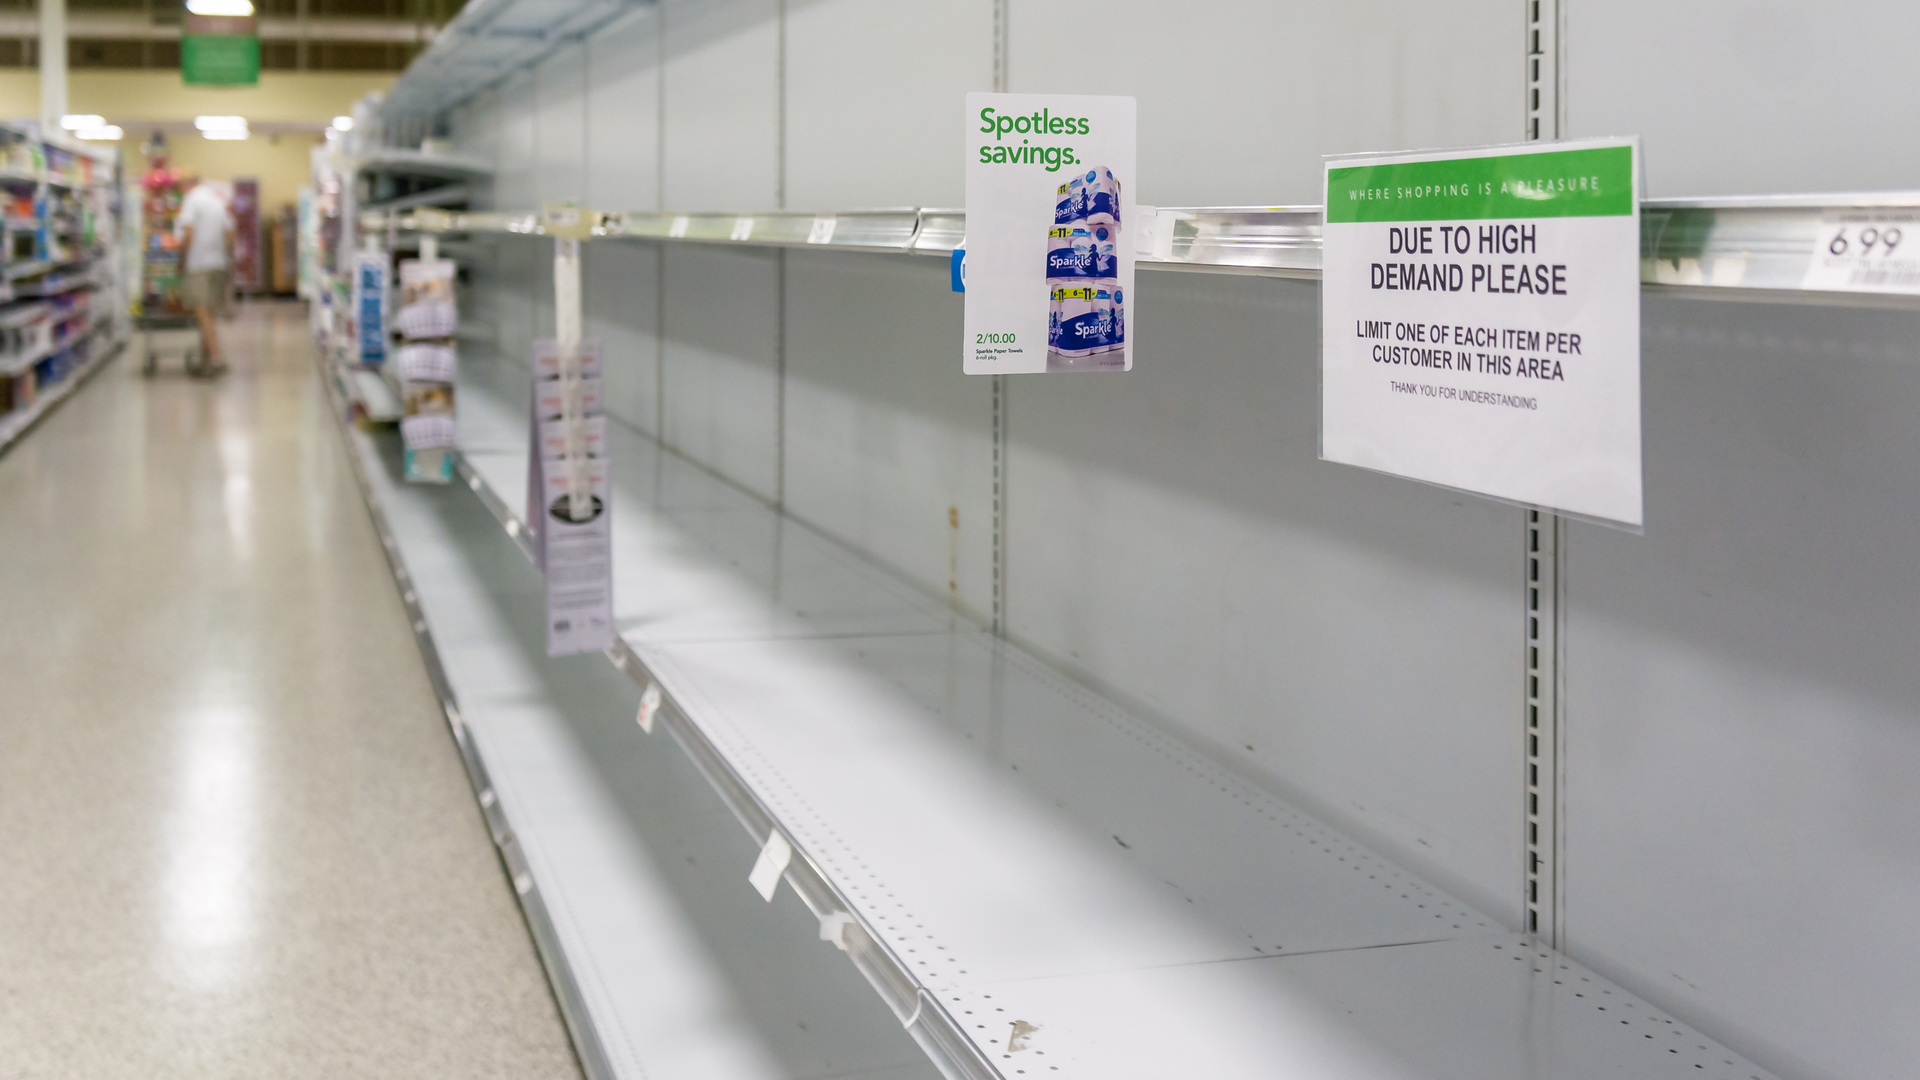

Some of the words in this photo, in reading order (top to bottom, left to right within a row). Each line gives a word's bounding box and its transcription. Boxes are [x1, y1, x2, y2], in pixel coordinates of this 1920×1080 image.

[979, 107, 1090, 141] Spotless
[979, 139, 1081, 173] savings.
[1349, 187, 1390, 201] WHERE
[1397, 183, 1469, 199] SHOPPING
[1478, 181, 1492, 196] IS
[1500, 181, 1509, 195] A
[1517, 175, 1599, 195] PLEASURE
[1389, 226, 1433, 255] DUE
[1440, 225, 1471, 255] TO
[1478, 224, 1537, 254] HIGH
[1049, 253, 1091, 269] Sparkle
[1370, 262, 1464, 292] DEMAND
[1471, 264, 1568, 296] PLEASE
[976, 332, 1016, 344] 2/10.00
[1075, 320, 1112, 339] Sparkle
[1356, 319, 1392, 340] LIMIT
[1395, 322, 1426, 343] ONE
[1429, 324, 1450, 344] OF
[1454, 326, 1498, 348] EACH
[1502, 329, 1541, 352] ITEM
[1545, 332, 1583, 355] PER
[1372, 344, 1452, 370] CUSTOMER
[1457, 352, 1472, 372] IN
[1476, 353, 1512, 376] THIS
[1516, 357, 1565, 382] AREA
[1390, 380, 1418, 395] THANK
[1419, 384, 1437, 398] YOU
[1438, 386, 1457, 400] FOR
[1458, 388, 1538, 411] UNDERSTANDING
